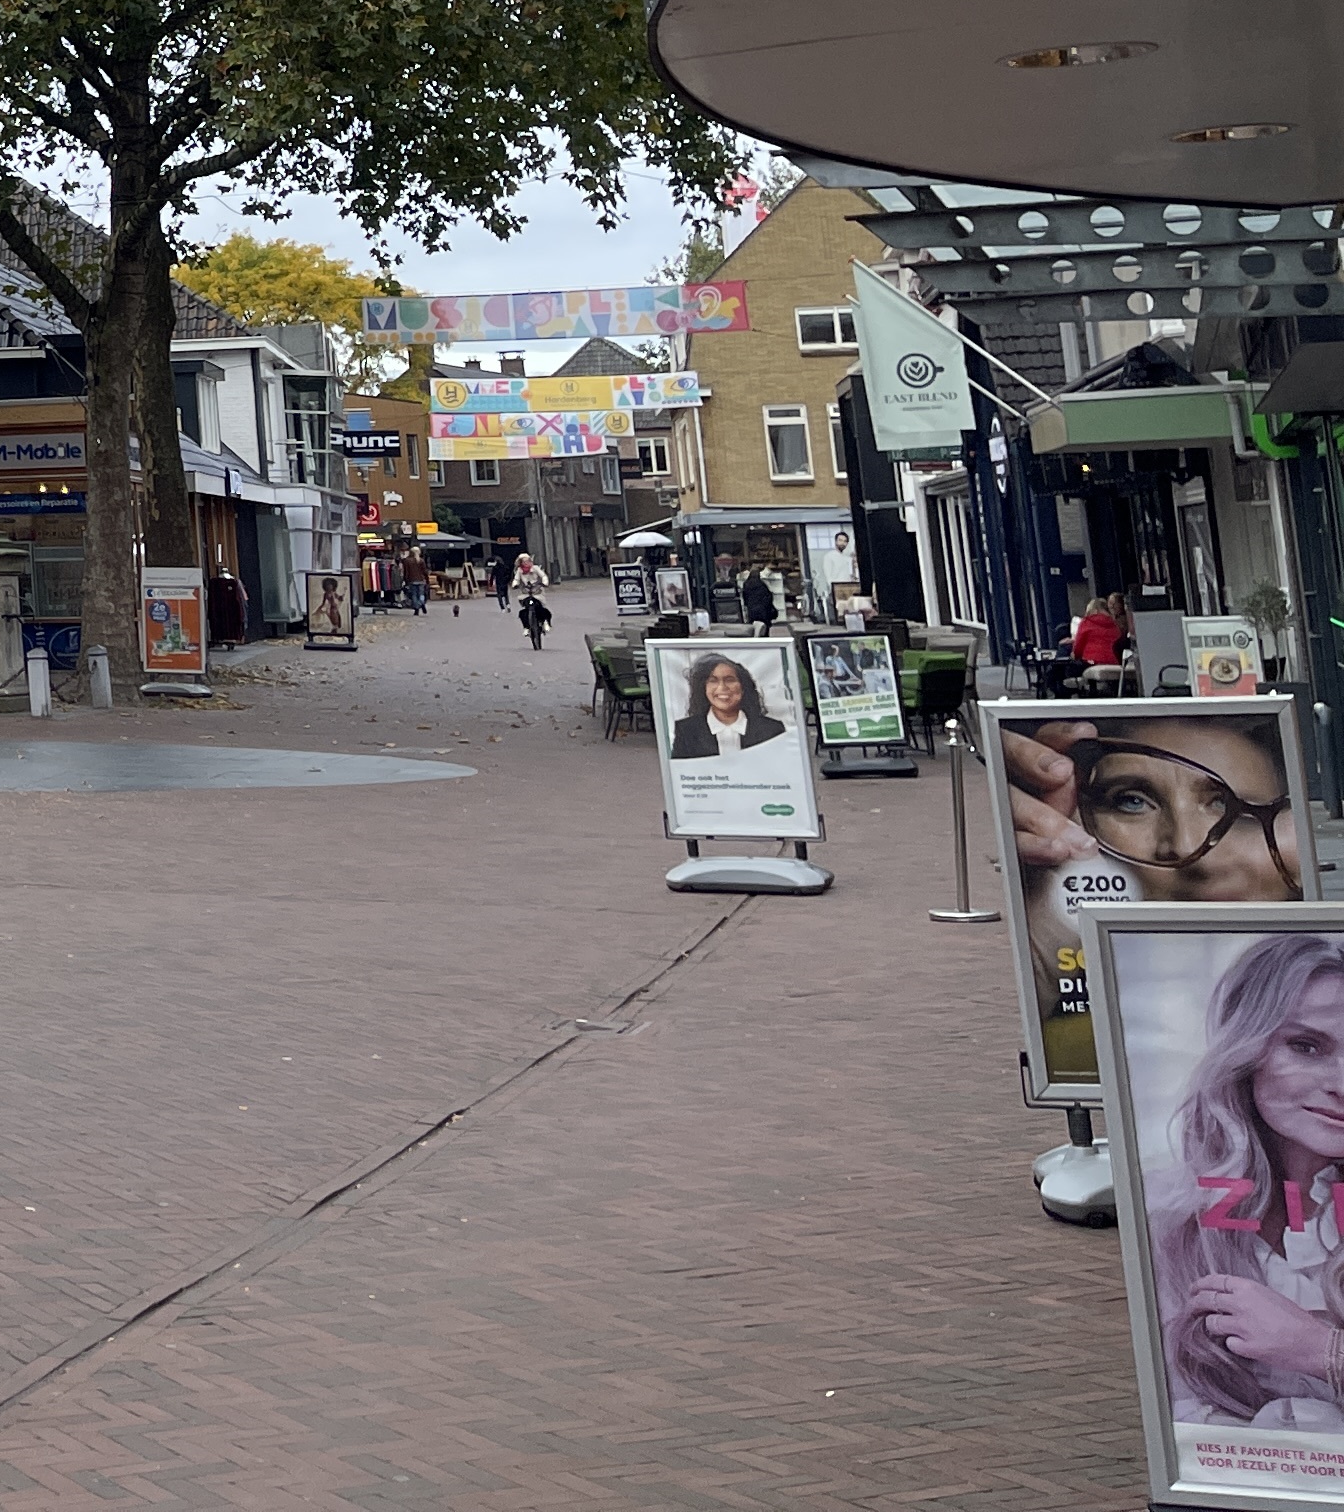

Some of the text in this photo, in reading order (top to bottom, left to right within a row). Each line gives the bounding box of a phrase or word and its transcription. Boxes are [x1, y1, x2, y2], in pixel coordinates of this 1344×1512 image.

[1059, 978, 1088, 994] DI
[1196, 1443, 1222, 1454] KIES
[1225, 1445, 1237, 1455] JE
[1240, 1446, 1306, 1461] FAVORIETE
[1197, 1456, 1234, 1469] VOOR
[1237, 1459, 1278, 1472] JEZELF
[1280, 1463, 1297, 1474] OF
[1300, 1465, 1337, 1478] VOOR
